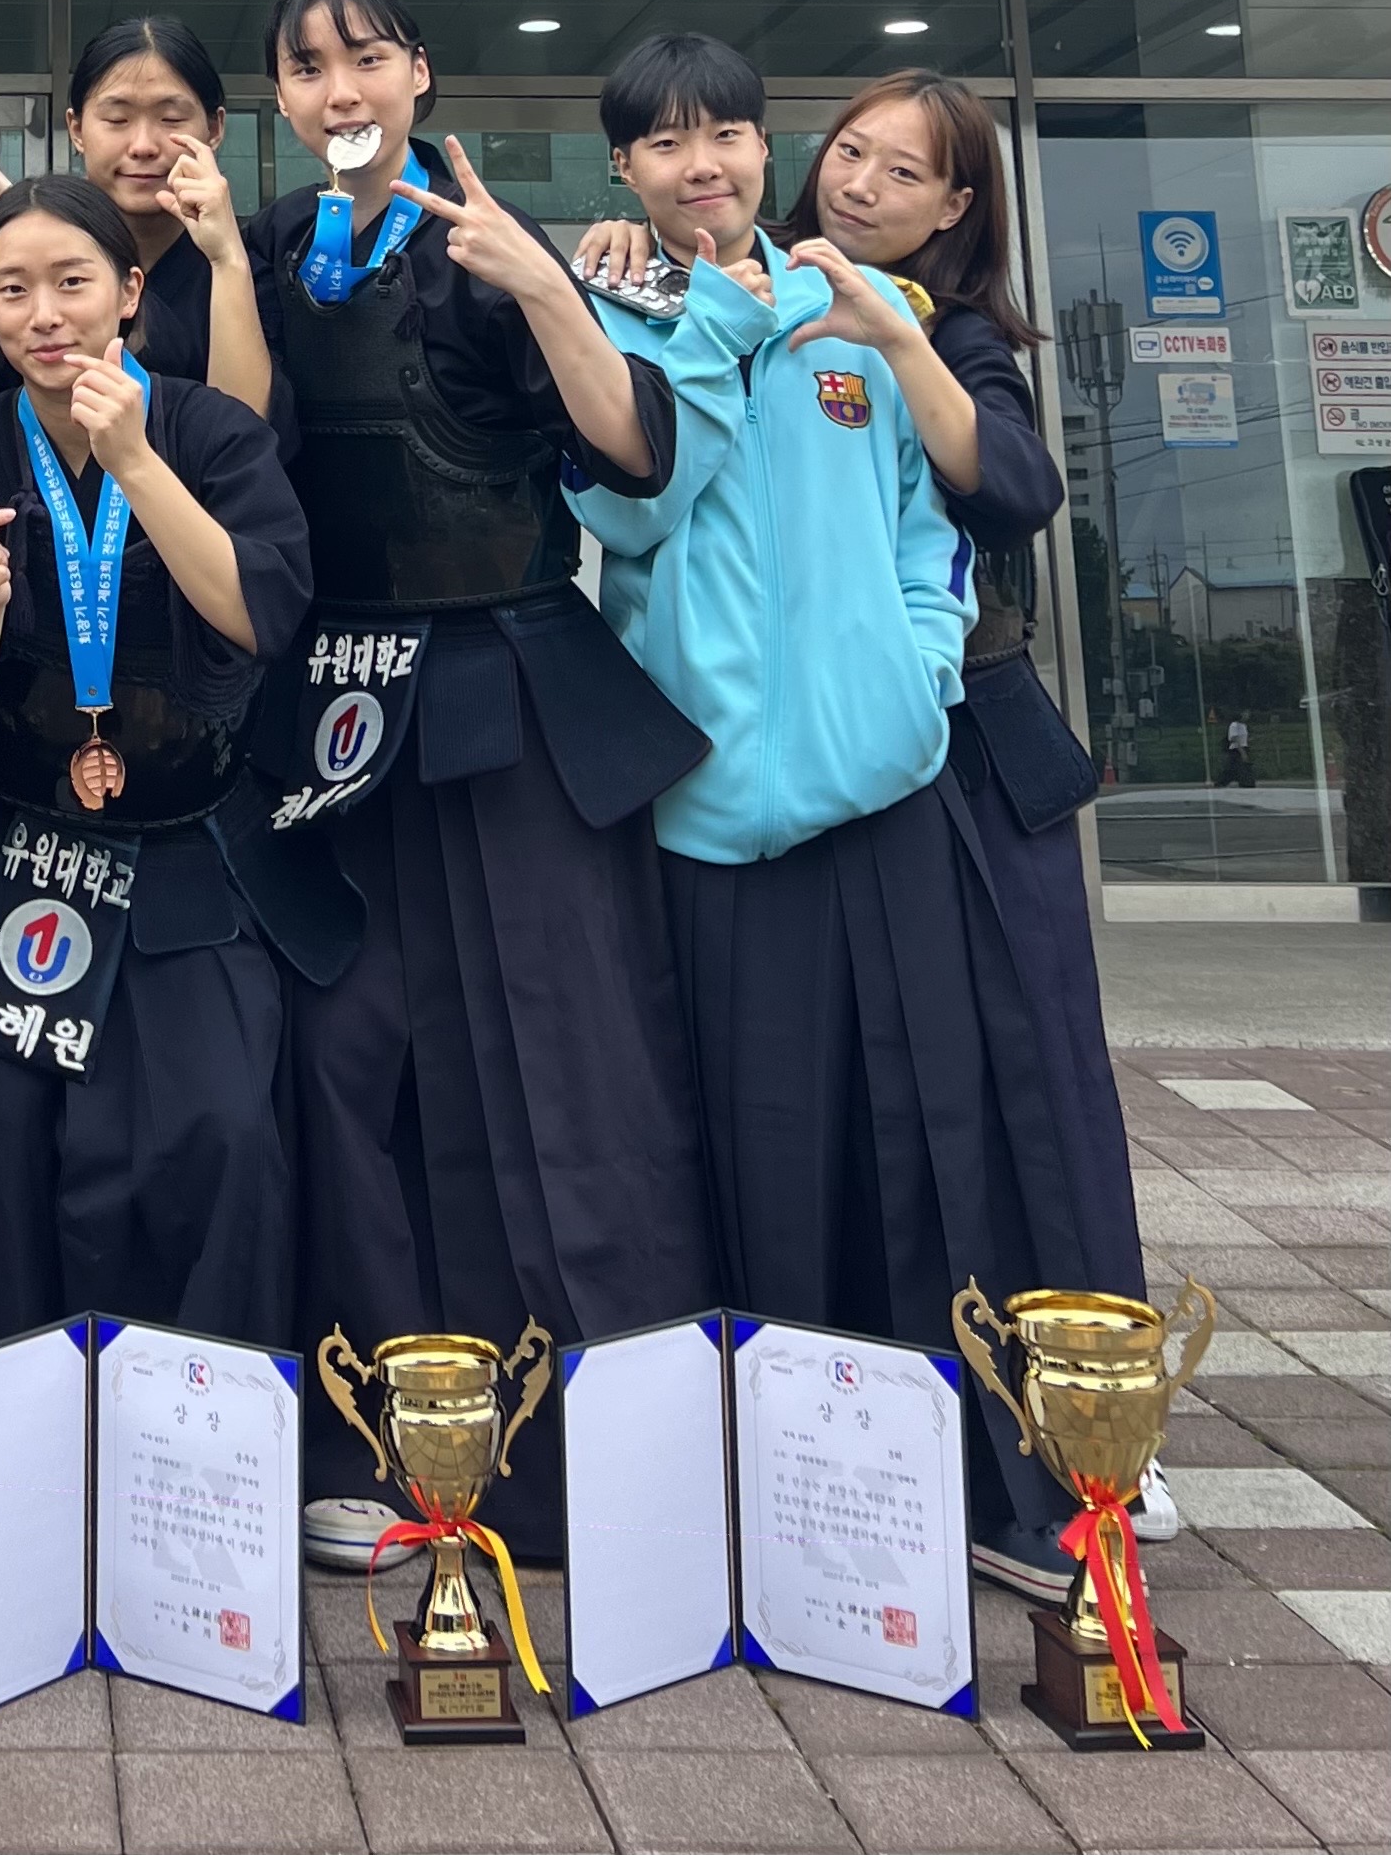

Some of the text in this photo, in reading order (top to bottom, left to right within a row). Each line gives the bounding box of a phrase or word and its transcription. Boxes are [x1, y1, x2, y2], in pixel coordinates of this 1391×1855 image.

[1321, 285, 1356, 300] AED
[1164, 336, 1227, 353] CCTV녹화중
[1370, 341, 1391, 355] 반입
[1344, 376, 1373, 389] 애완견
[66, 559, 85, 603] 제63회
[97, 560, 113, 603] 제63회
[73, 606, 92, 646] 회장기
[308, 633, 419, 687] 유원대학교
[2, 822, 135, 909] 유원대학교
[173, 1403, 221, 1432] 상 장
[818, 1401, 872, 1430] 상 장
